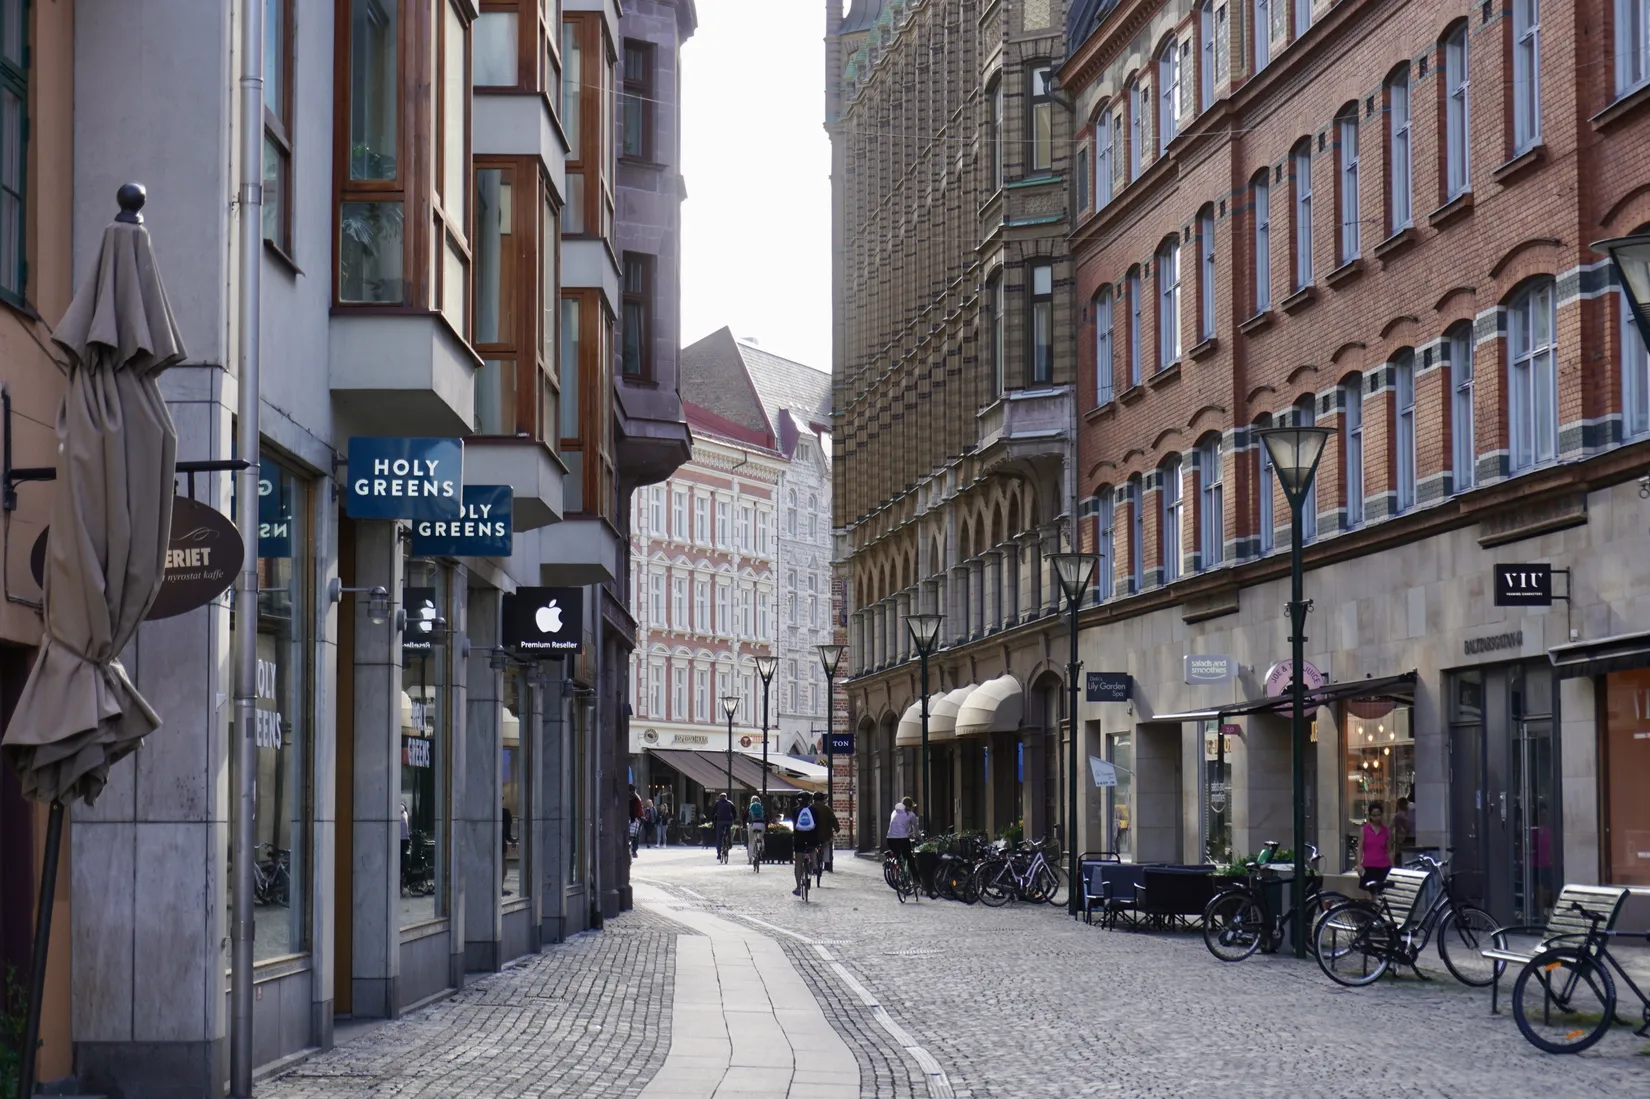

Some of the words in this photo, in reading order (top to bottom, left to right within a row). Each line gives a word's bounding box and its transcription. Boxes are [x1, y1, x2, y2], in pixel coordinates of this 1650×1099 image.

[374, 458, 440, 477] HOLY
[354, 478, 454, 498] GREENS
[461, 504, 492, 519] LY
[418, 521, 506, 537] GREENS
[165, 547, 211, 568] ERIET
[203, 569, 224, 581] kaffe
[521, 641, 551, 649] Premium
[551, 641, 578, 649] Reseller
[1191, 660, 1211, 668] salads
[1212, 660, 1227, 668] and
[257, 659, 277, 700] OLY
[1271, 669, 1283, 684] JOE
[1281, 665, 1288, 673] &
[1303, 666, 1321, 684] JUICE
[1088, 682, 1099, 692] Lily
[1100, 682, 1126, 690] Garden
[1112, 690, 1124, 698] Spa
[256, 708, 282, 750] EENS
